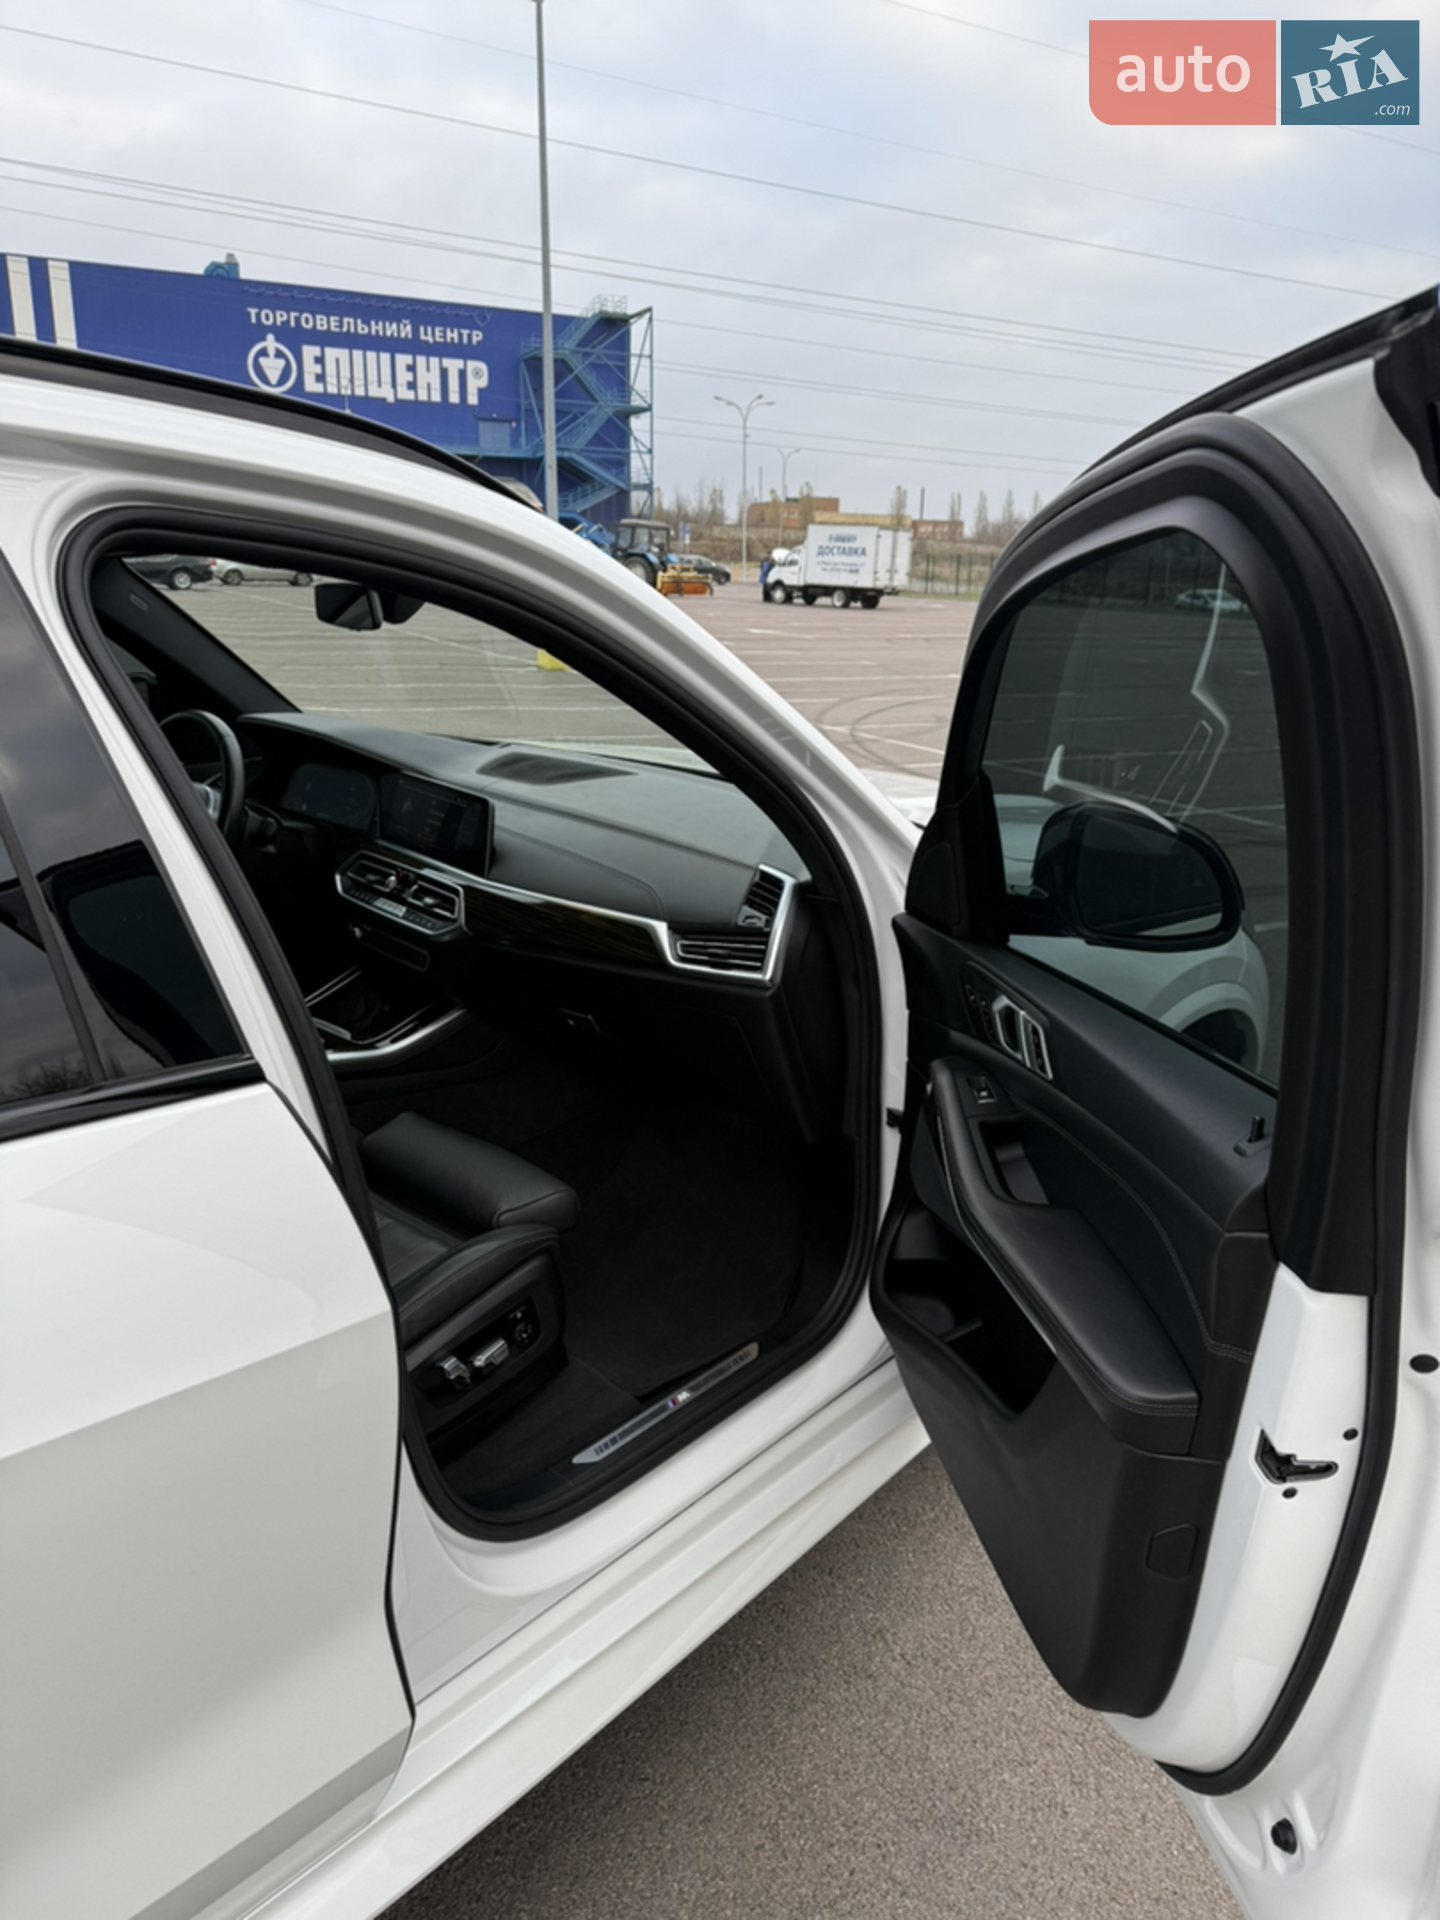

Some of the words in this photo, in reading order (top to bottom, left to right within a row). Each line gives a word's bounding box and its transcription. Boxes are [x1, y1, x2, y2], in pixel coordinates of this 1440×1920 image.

[247, 307, 413, 339] ТОРГОВЕЛЬНИЙ
[419, 325, 484, 346] ЦЕНТР
[301, 344, 490, 406] ЕПІЦЕНТР
[816, 545, 867, 557] ДОСТАВКА
